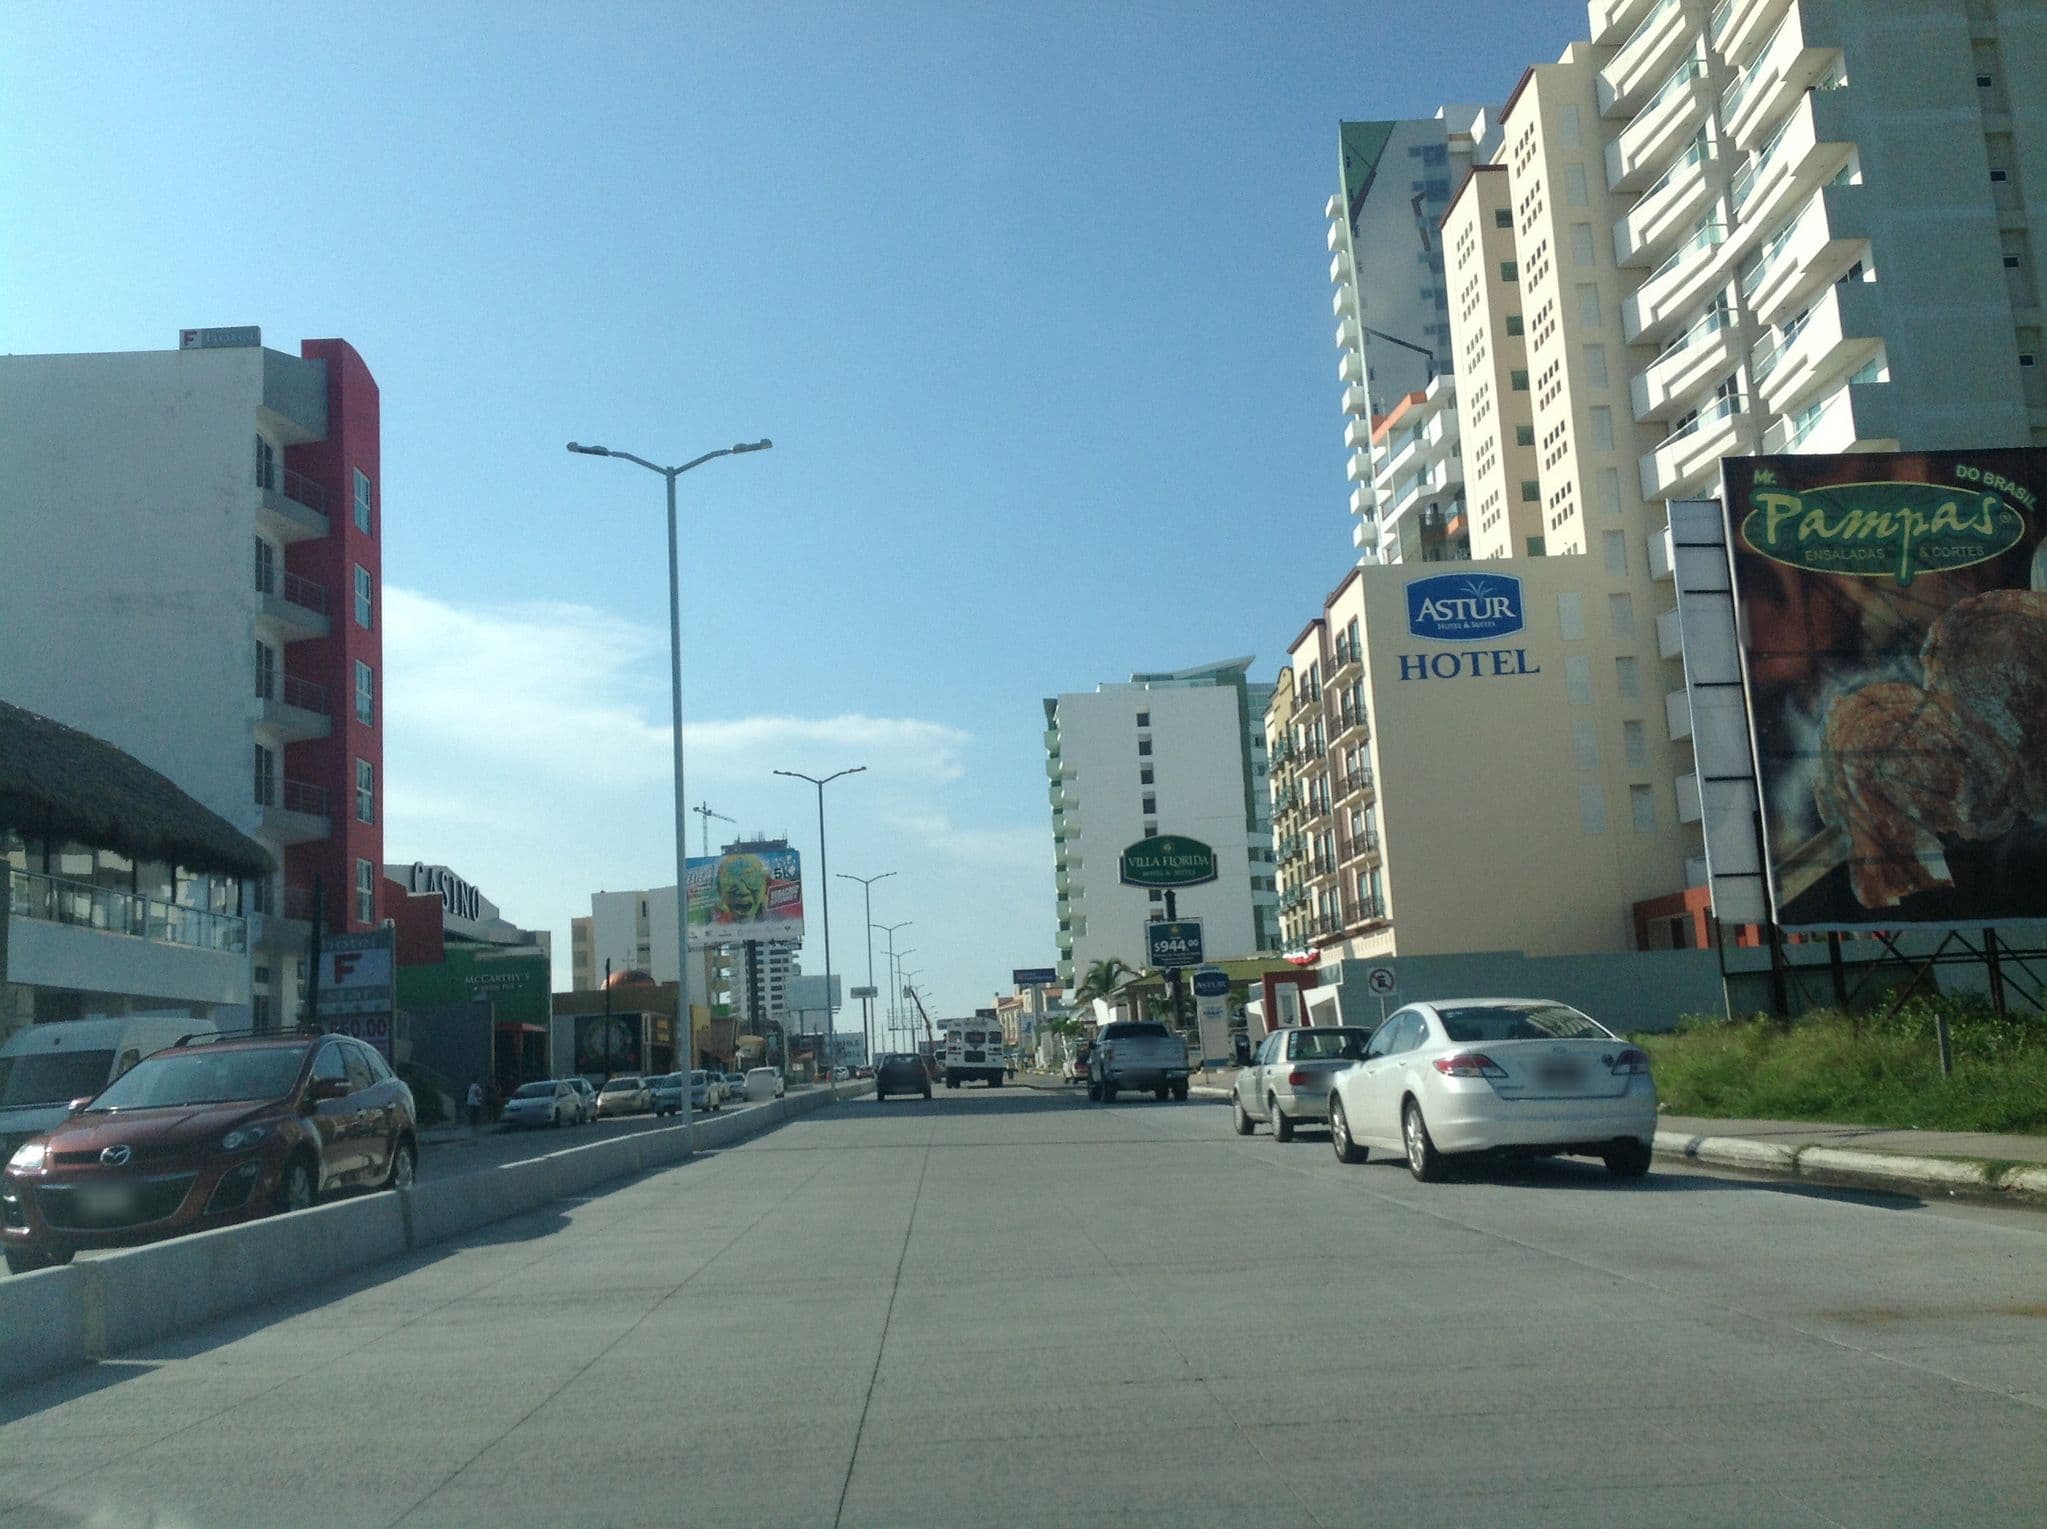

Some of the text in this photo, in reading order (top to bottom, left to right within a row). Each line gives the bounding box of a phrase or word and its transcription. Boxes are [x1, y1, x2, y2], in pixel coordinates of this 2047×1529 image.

[1753, 470, 1776, 486] Mr.
[1956, 464, 2038, 511] DO BRASIL
[1755, 494, 1997, 579] Pampas
[1805, 549, 1886, 562] ENSALADAS
[1932, 545, 1986, 558] CORTES
[1416, 597, 1517, 622] ASTUR
[1398, 648, 1541, 680] HOTEL
[1128, 855, 1210, 867] VILLA FLORIDA
[410, 861, 481, 921] CASINO
[335, 953, 362, 984] F
